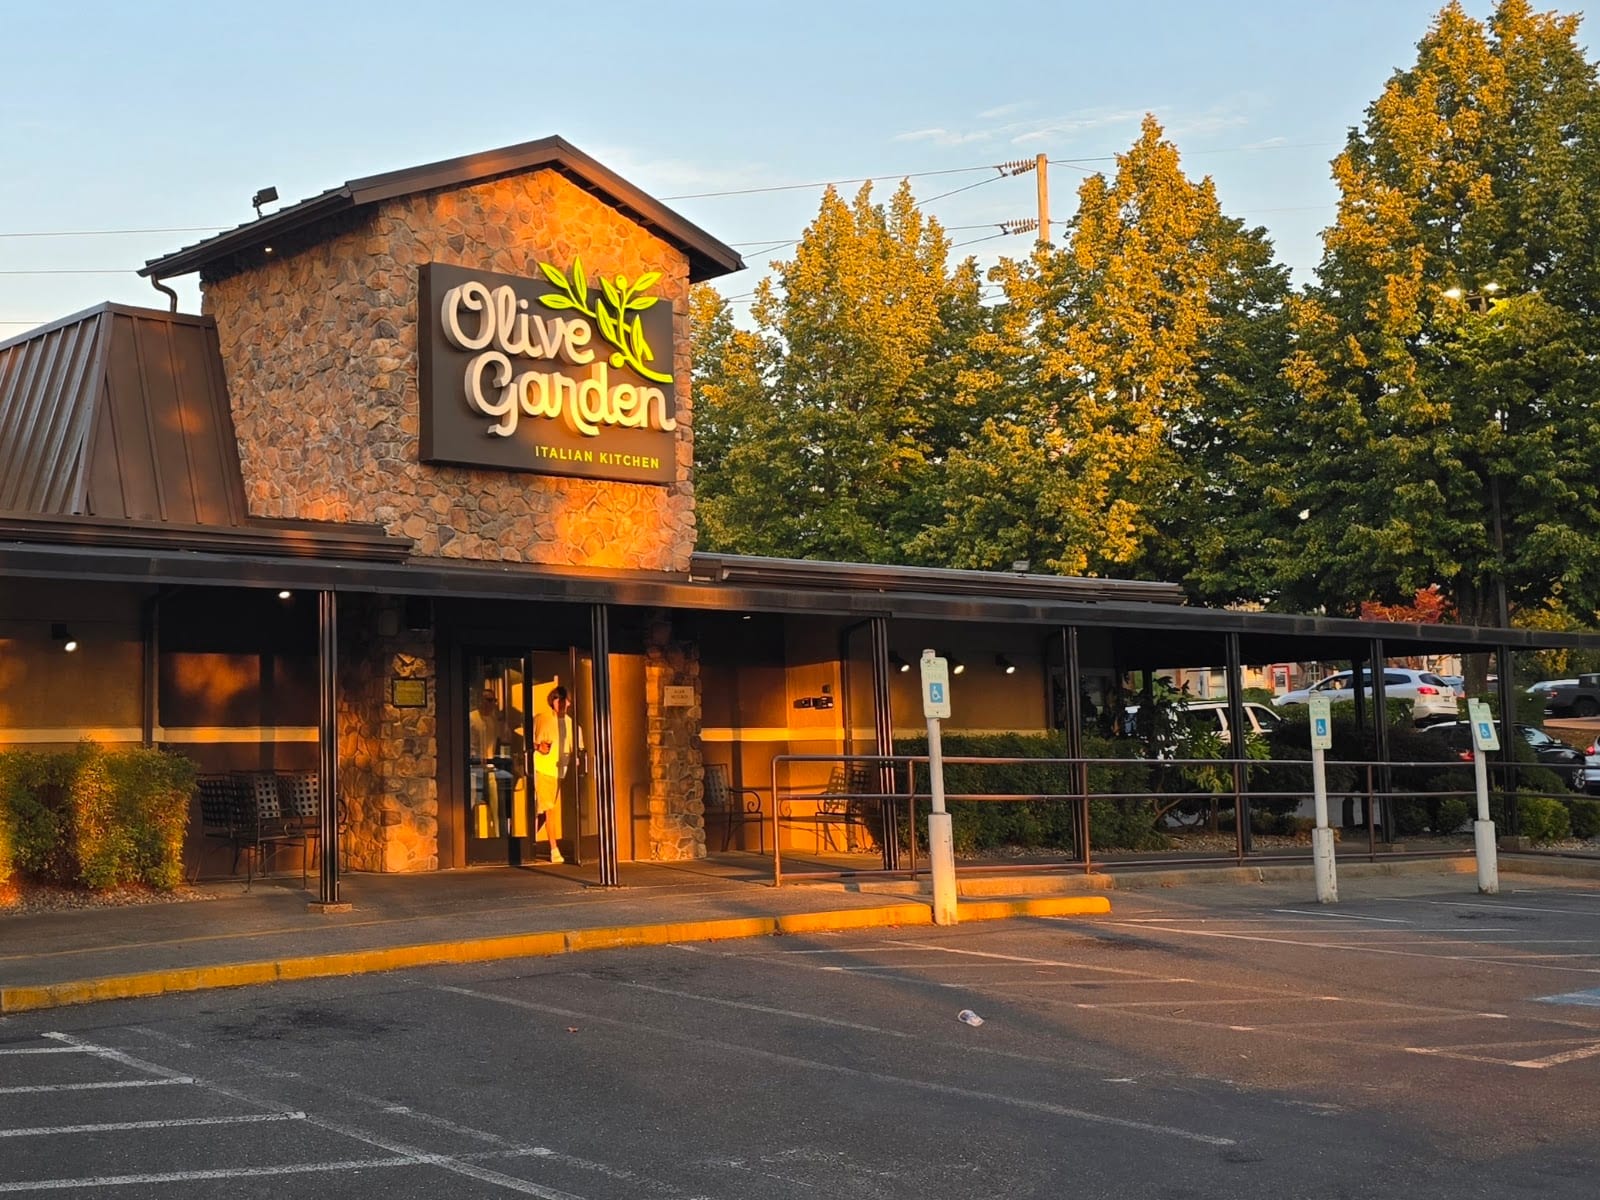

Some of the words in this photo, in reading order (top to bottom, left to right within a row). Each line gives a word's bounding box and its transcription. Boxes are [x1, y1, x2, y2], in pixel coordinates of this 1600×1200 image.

[441, 281, 595, 364] Olive
[465, 351, 677, 437] Garden
[535, 445, 593, 462] ITALIAN
[599, 452, 659, 469] KITCHEN
